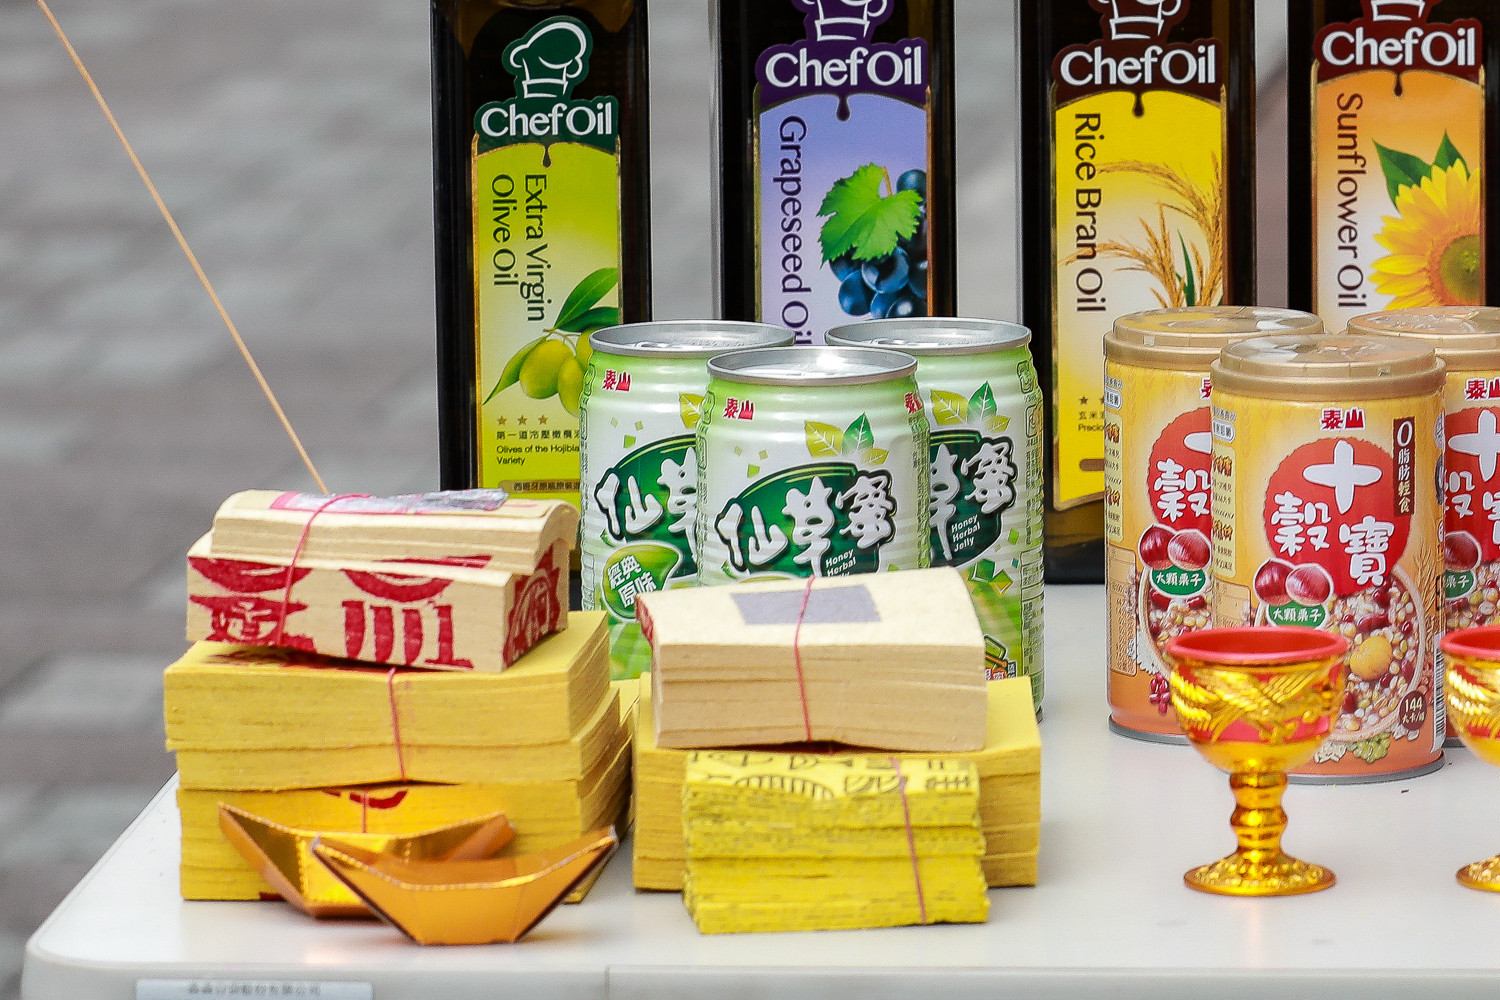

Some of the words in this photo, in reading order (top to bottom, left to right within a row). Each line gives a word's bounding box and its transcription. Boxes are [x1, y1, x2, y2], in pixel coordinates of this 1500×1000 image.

[1322, 26, 1475, 66] ChefOil
[765, 46, 922, 87] ChefOil
[1061, 45, 1215, 86] ChefOil
[481, 102, 612, 136] ChefOil
[1075, 113, 1105, 181] Rice
[1337, 93, 1366, 258] Sunflower
[492, 174, 517, 242] Olive
[525, 174, 547, 240] Extra
[773, 116, 812, 293] Grapeseed
[1075, 188, 1102, 260] Bran
[493, 249, 518, 285] Oil
[520, 243, 552, 321] Virgin
[1076, 268, 1106, 312] Oil
[1337, 265, 1367, 307] Oil
[602, 370, 631, 392] 泰山
[723, 398, 754, 420] 泰山
[1321, 408, 1364, 429] 泰山
[497, 456, 525, 466] Variety
[951, 514, 978, 534] Honey
[952, 524, 981, 543] Herbal
[825, 549, 854, 568] Honey
[954, 536, 975, 552] Jelly
[607, 555, 642, 590] 經典
[1155, 571, 1202, 588] 大顆栗子
[1273, 604, 1323, 623] 大顆栗子
[1404, 696, 1423, 713] 144
